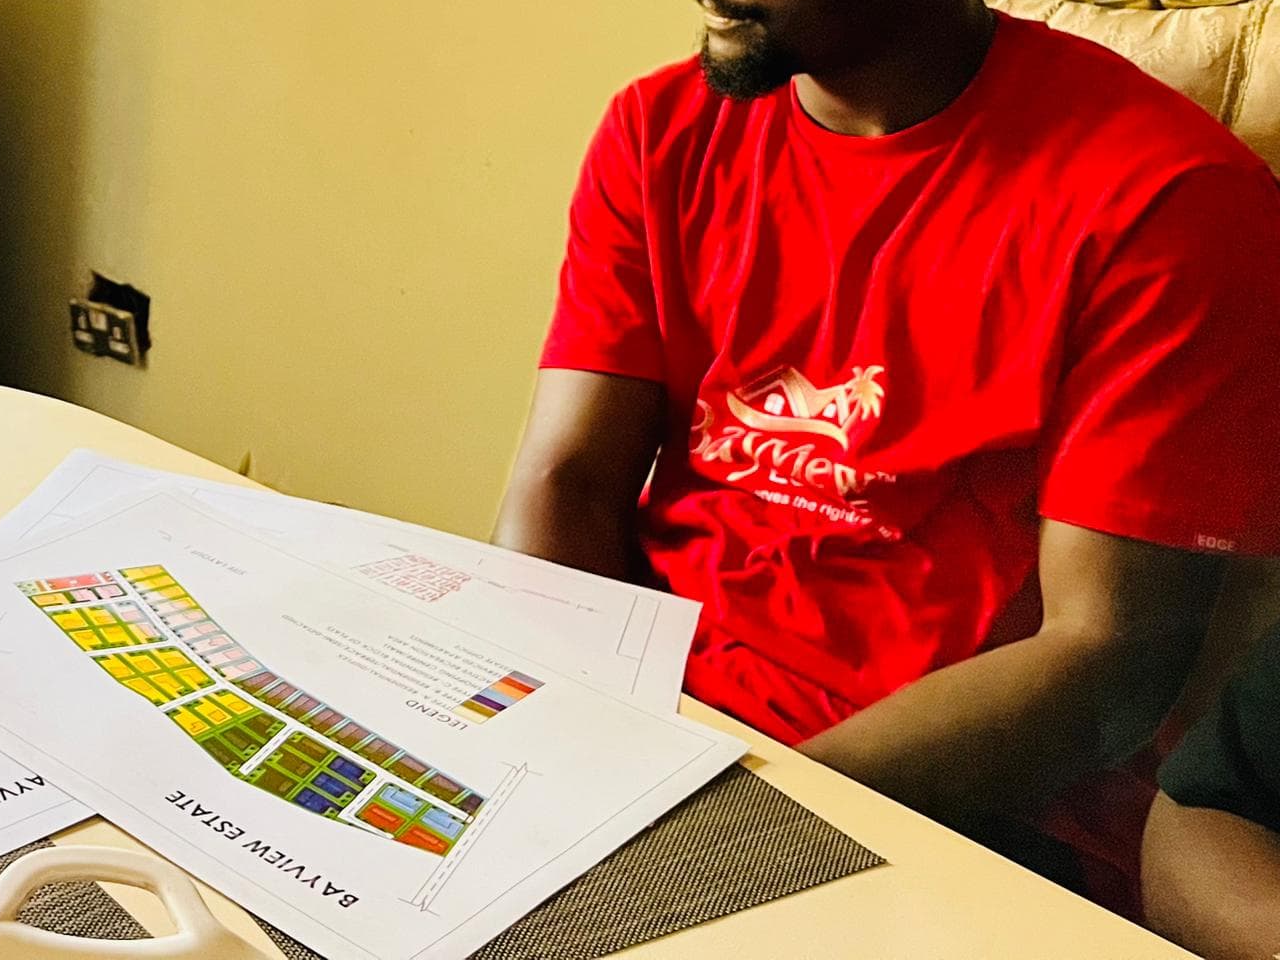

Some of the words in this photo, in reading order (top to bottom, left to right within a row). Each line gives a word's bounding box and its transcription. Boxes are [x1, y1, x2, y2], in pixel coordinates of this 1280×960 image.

[792, 495, 818, 512] the
[405, 698, 468, 731] LEGEND
[164, 790, 246, 840] ESTATE
[242, 839, 360, 908] BAYVIEW
